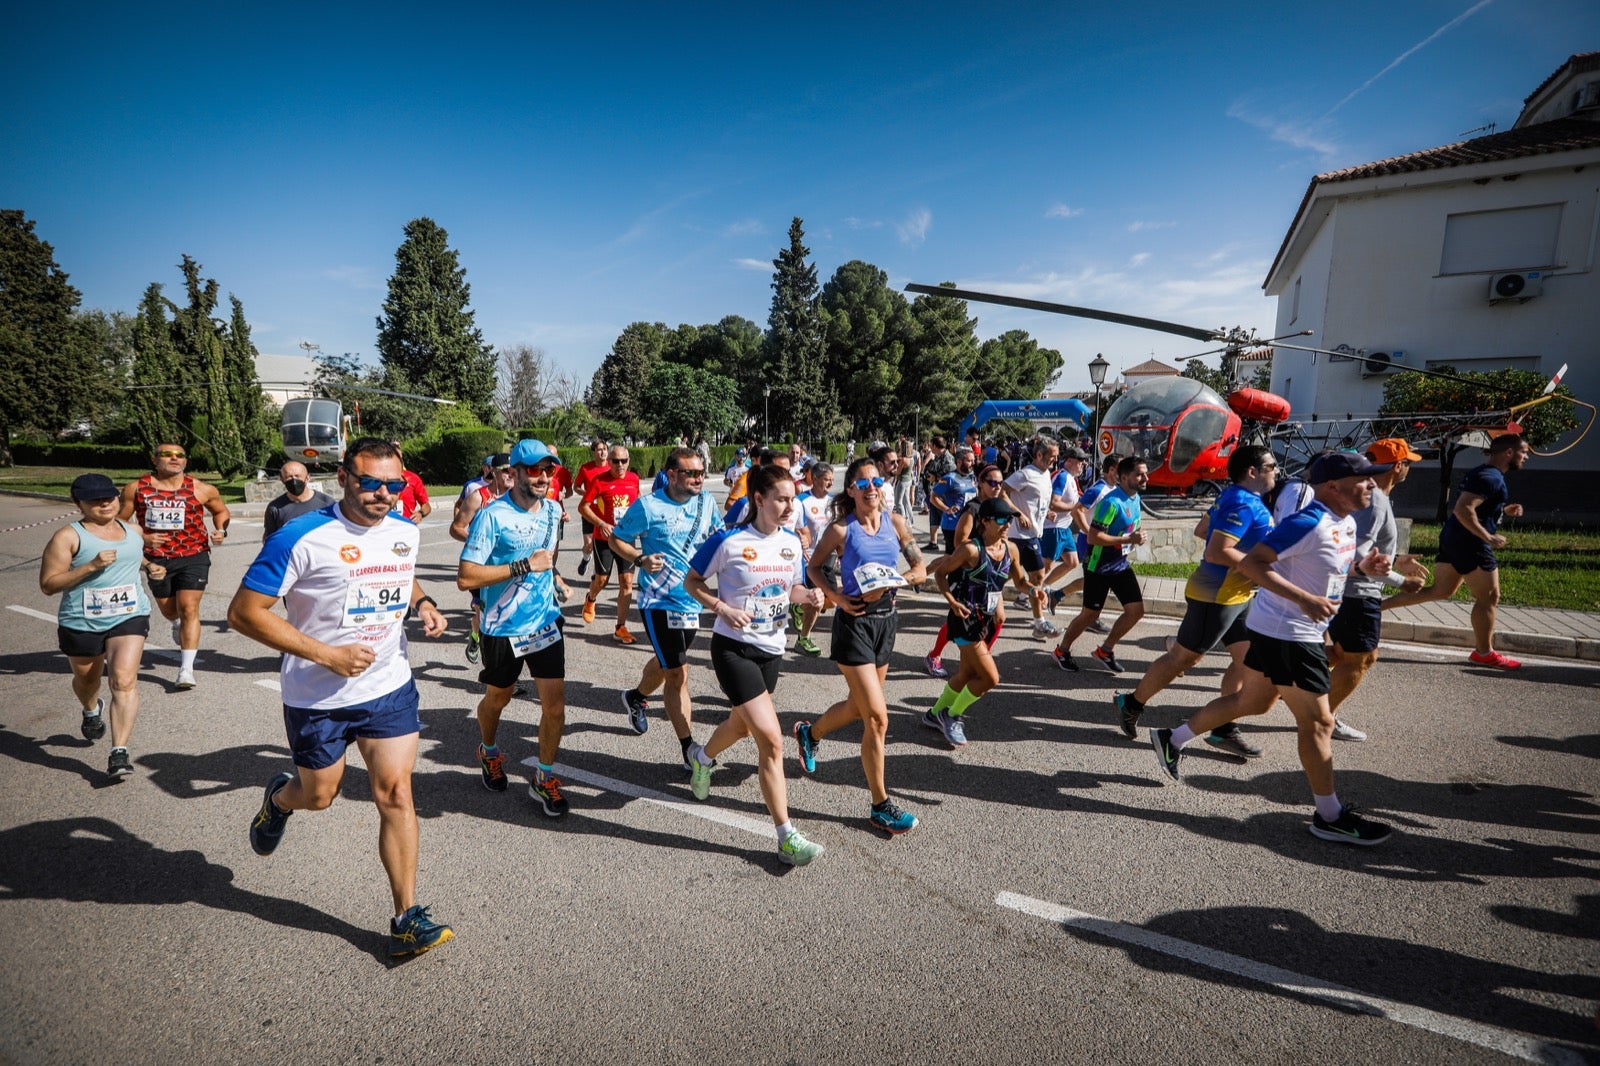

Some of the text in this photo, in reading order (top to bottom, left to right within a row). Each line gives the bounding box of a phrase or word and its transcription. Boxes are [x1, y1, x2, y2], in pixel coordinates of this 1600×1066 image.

[144, 500, 186, 508] KENYA
[159, 512, 180, 521] 142
[356, 566, 381, 576] CARRERA
[382, 564, 398, 573] BASE
[752, 565, 772, 573] CARRERA
[877, 567, 894, 577] 35
[110, 591, 129, 604] 44
[378, 587, 401, 605] 94
[768, 602, 783, 618] 36
